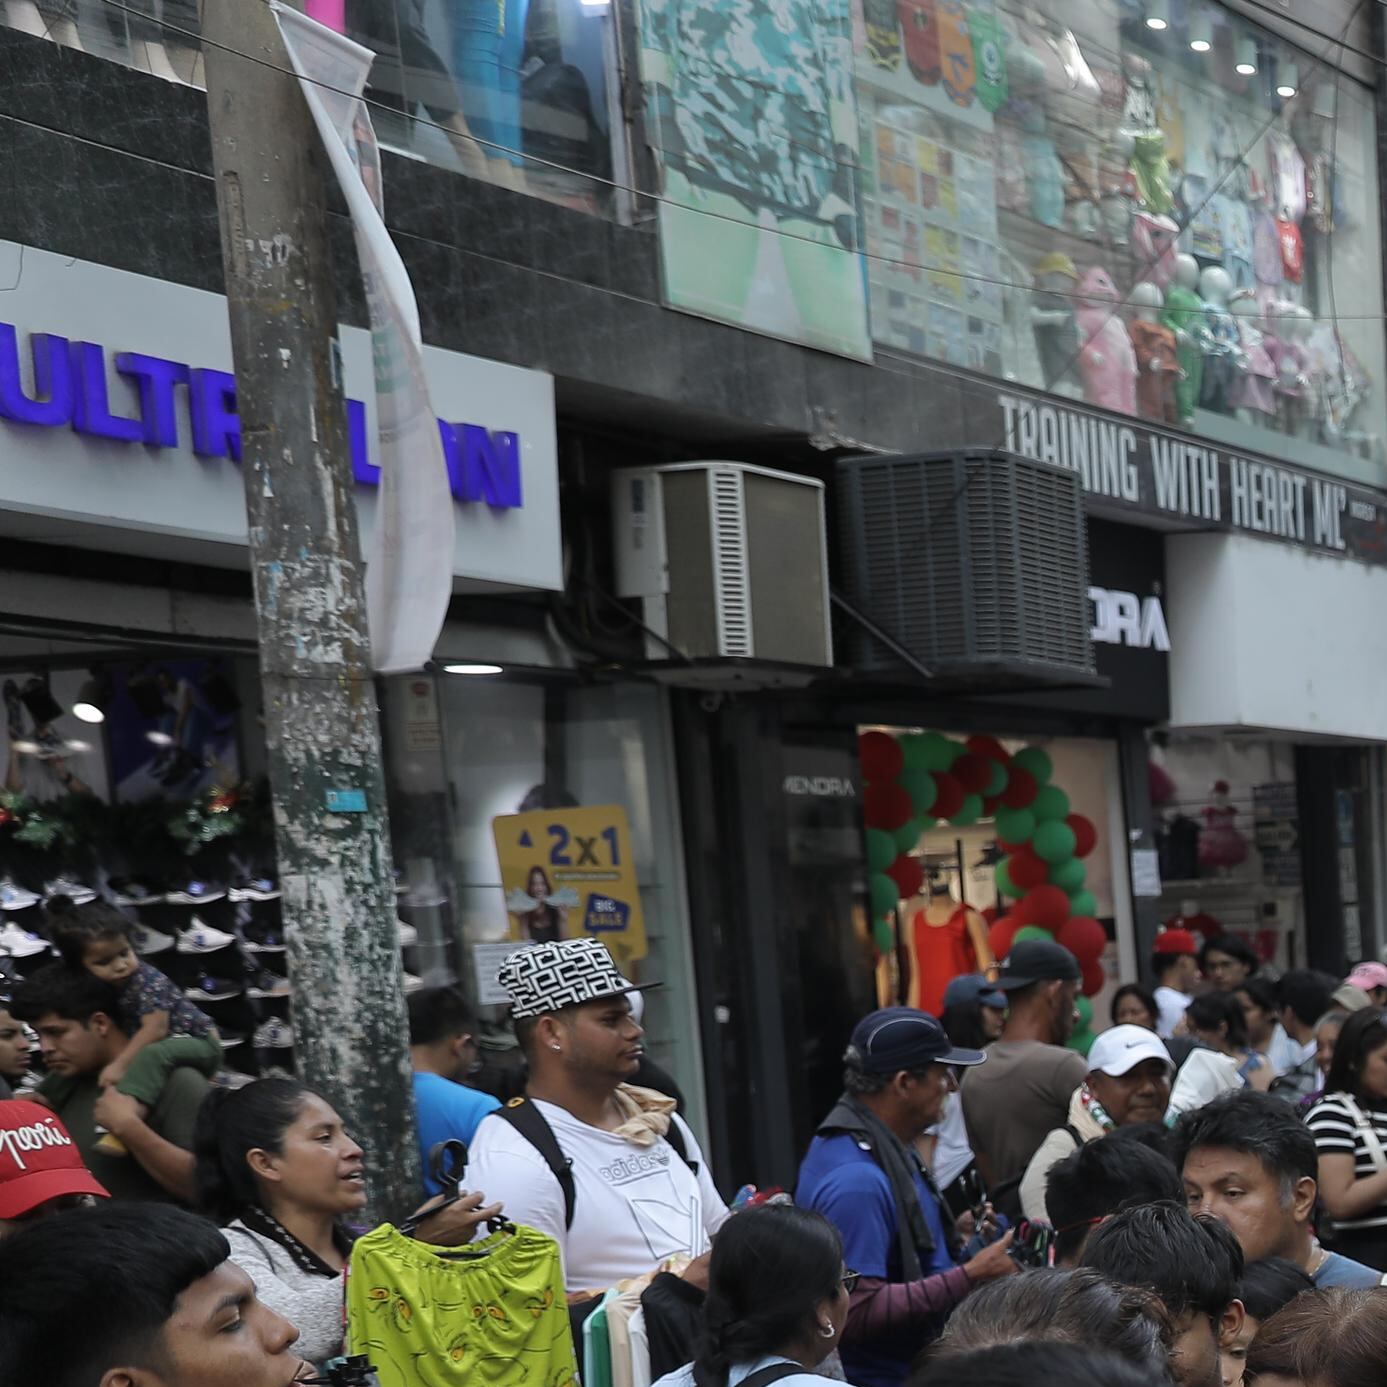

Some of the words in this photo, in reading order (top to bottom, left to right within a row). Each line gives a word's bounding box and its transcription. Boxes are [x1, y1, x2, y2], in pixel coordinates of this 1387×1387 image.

[0, 321, 524, 508] ULTRLN
[1150, 435, 1221, 521] WITH
[1229, 456, 1306, 541] HEART
[546, 824, 620, 867] 2x1
[598, 1154, 661, 1181] adidas
